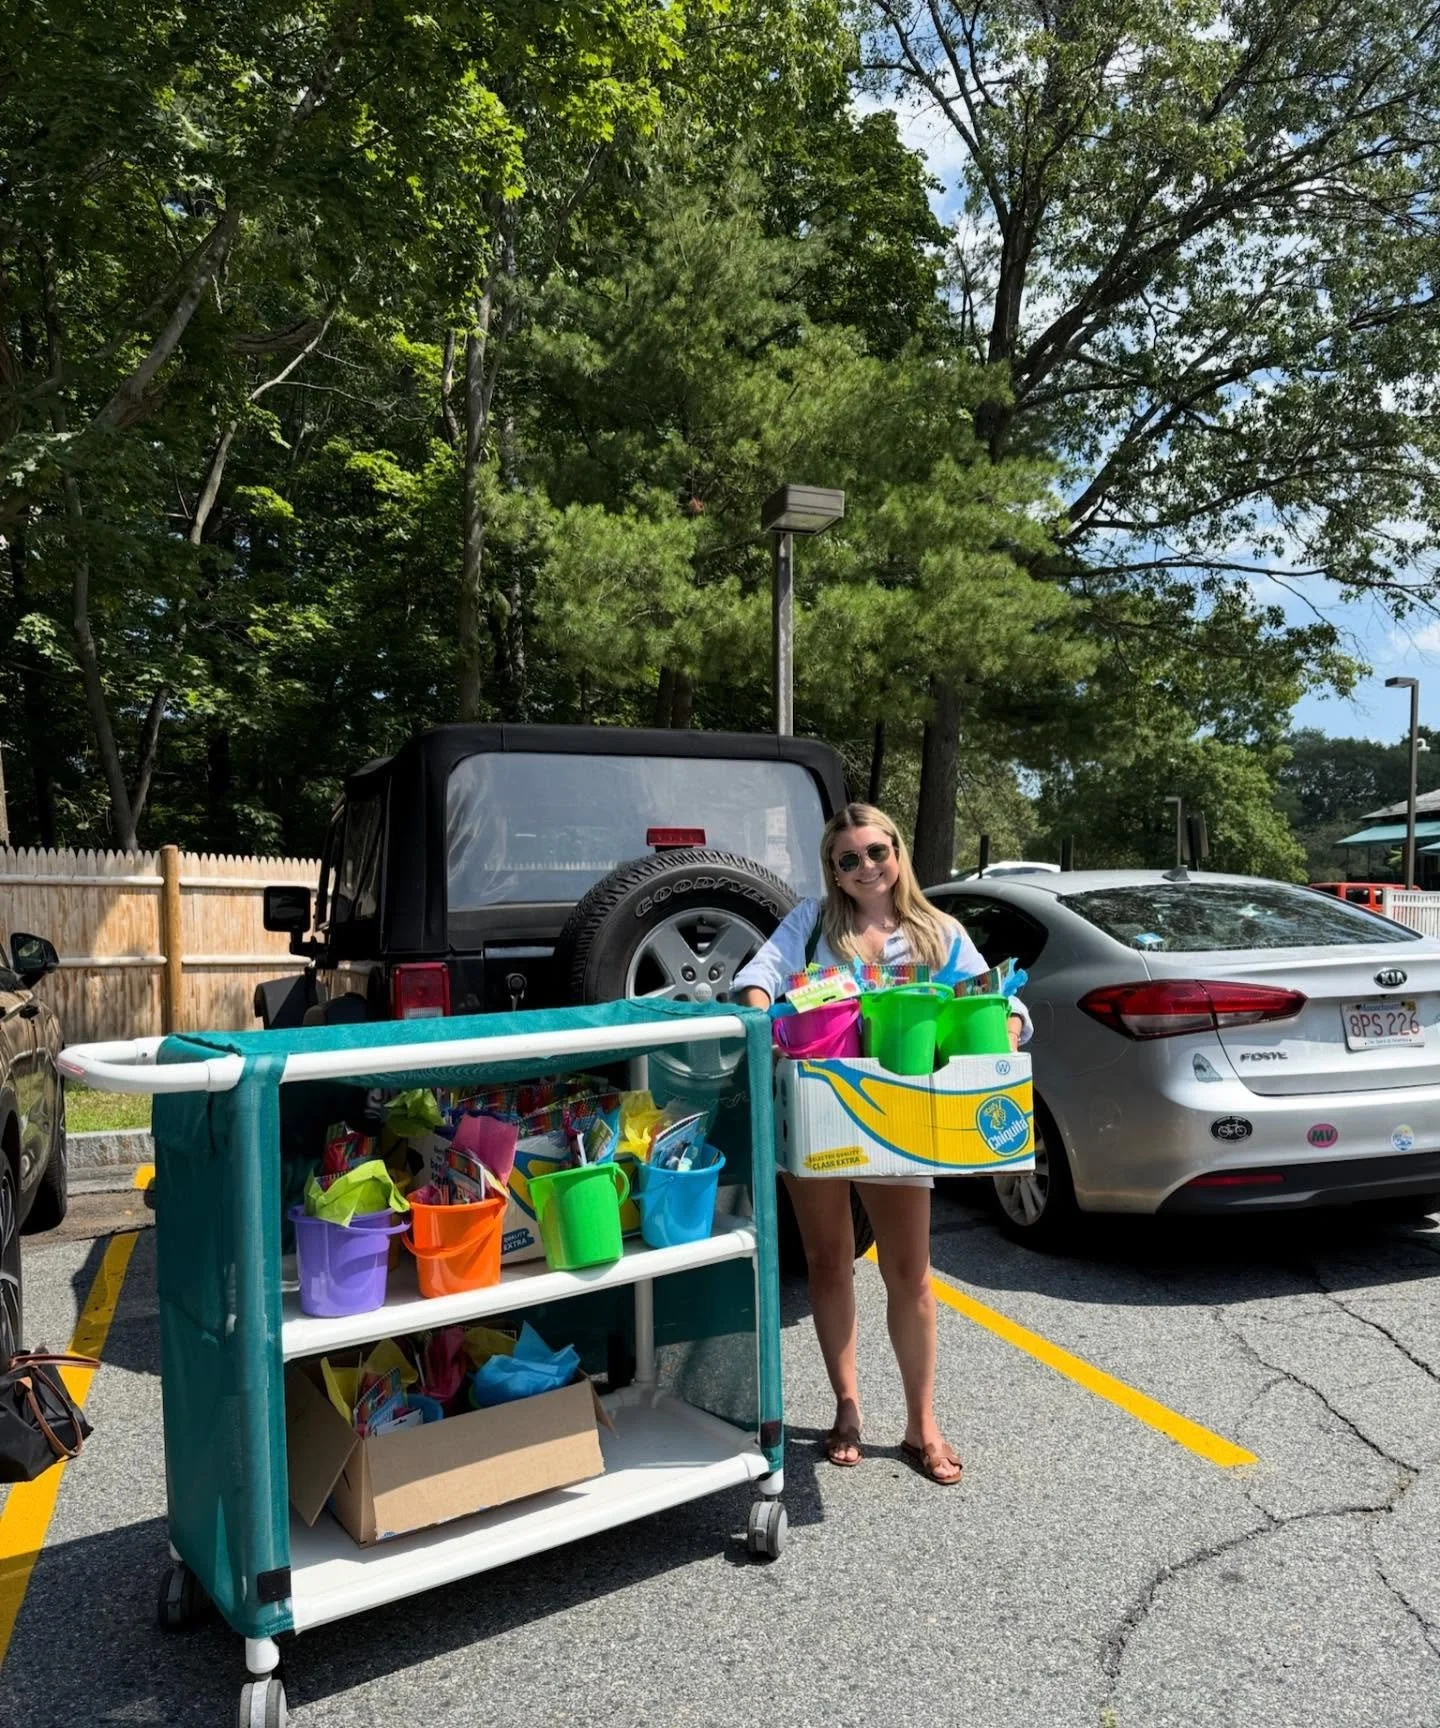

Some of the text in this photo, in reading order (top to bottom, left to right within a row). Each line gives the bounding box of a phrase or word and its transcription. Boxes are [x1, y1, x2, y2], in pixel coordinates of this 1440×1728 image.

[636, 876, 780, 918] GOODYEA
[1380, 970, 1405, 985] KIA
[1349, 1011, 1420, 1038] 8PS 226
[987, 1115, 1029, 1151] Chiquita
[1311, 1129, 1334, 1143] MV
[812, 1156, 861, 1170] CLASS EXTRA
